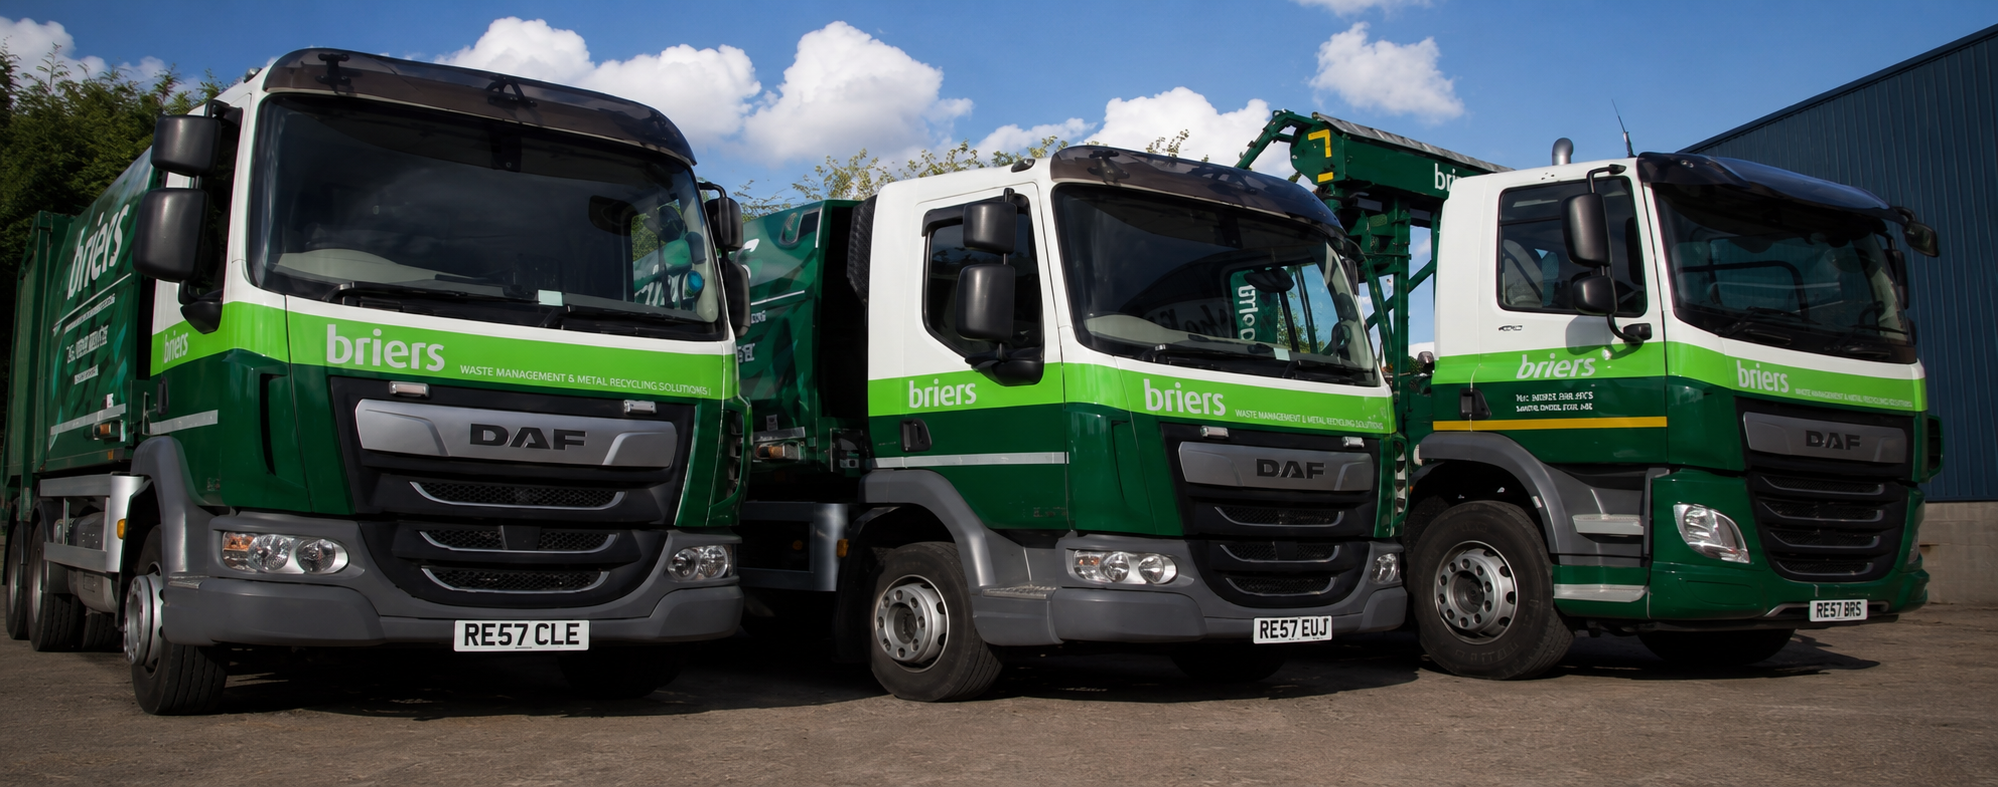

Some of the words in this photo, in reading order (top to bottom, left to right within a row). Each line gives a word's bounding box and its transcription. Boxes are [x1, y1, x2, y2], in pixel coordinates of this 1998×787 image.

[67, 204, 130, 300] briers
[164, 330, 189, 364] briers
[327, 324, 445, 372] briers
[460, 365, 494, 376] WASTE
[496, 368, 566, 383] MANAGEMENT
[568, 374, 575, 383] &
[577, 375, 608, 386] METAL
[610, 377, 657, 391] RECYCLING
[1516, 353, 1596, 379] briers
[1736, 360, 1789, 393] briers
[909, 378, 977, 408] briers
[1143, 378, 1226, 416] briers
[1235, 409, 1257, 419] WASTE
[469, 423, 586, 451] DAF
[1806, 430, 1860, 450] DAF
[1256, 458, 1325, 479] DAF
[1816, 602, 1842, 618] RE57
[1844, 601, 1862, 617] BRS
[464, 623, 529, 646] RE57
[535, 623, 580, 646] CLE
[1260, 620, 1298, 639] RE57
[1302, 618, 1329, 637] EUJ
